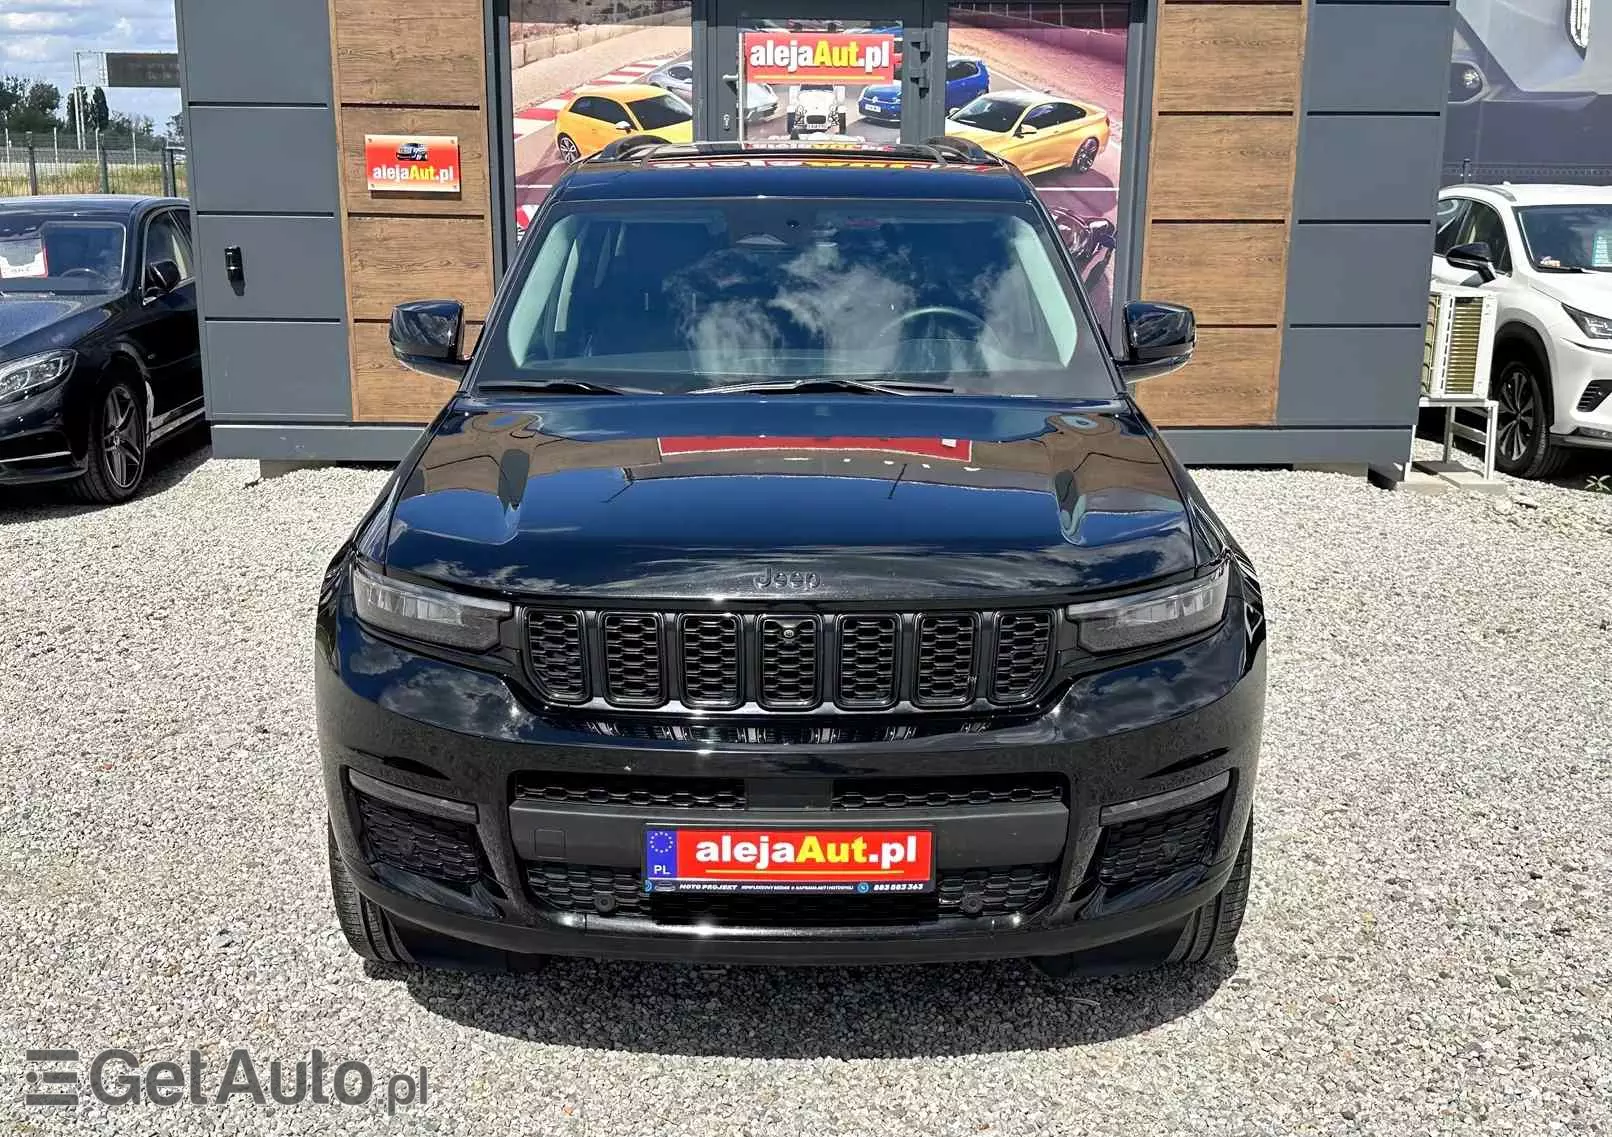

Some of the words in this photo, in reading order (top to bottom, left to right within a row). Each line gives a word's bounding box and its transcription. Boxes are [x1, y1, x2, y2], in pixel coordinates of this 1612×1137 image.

[750, 39, 890, 73] alejaAut.pl
[372, 164, 454, 182] alejaAut.pl
[753, 567, 820, 590] Jeep
[695, 834, 917, 870] alejaAut.pl
[654, 864, 671, 875] PL
